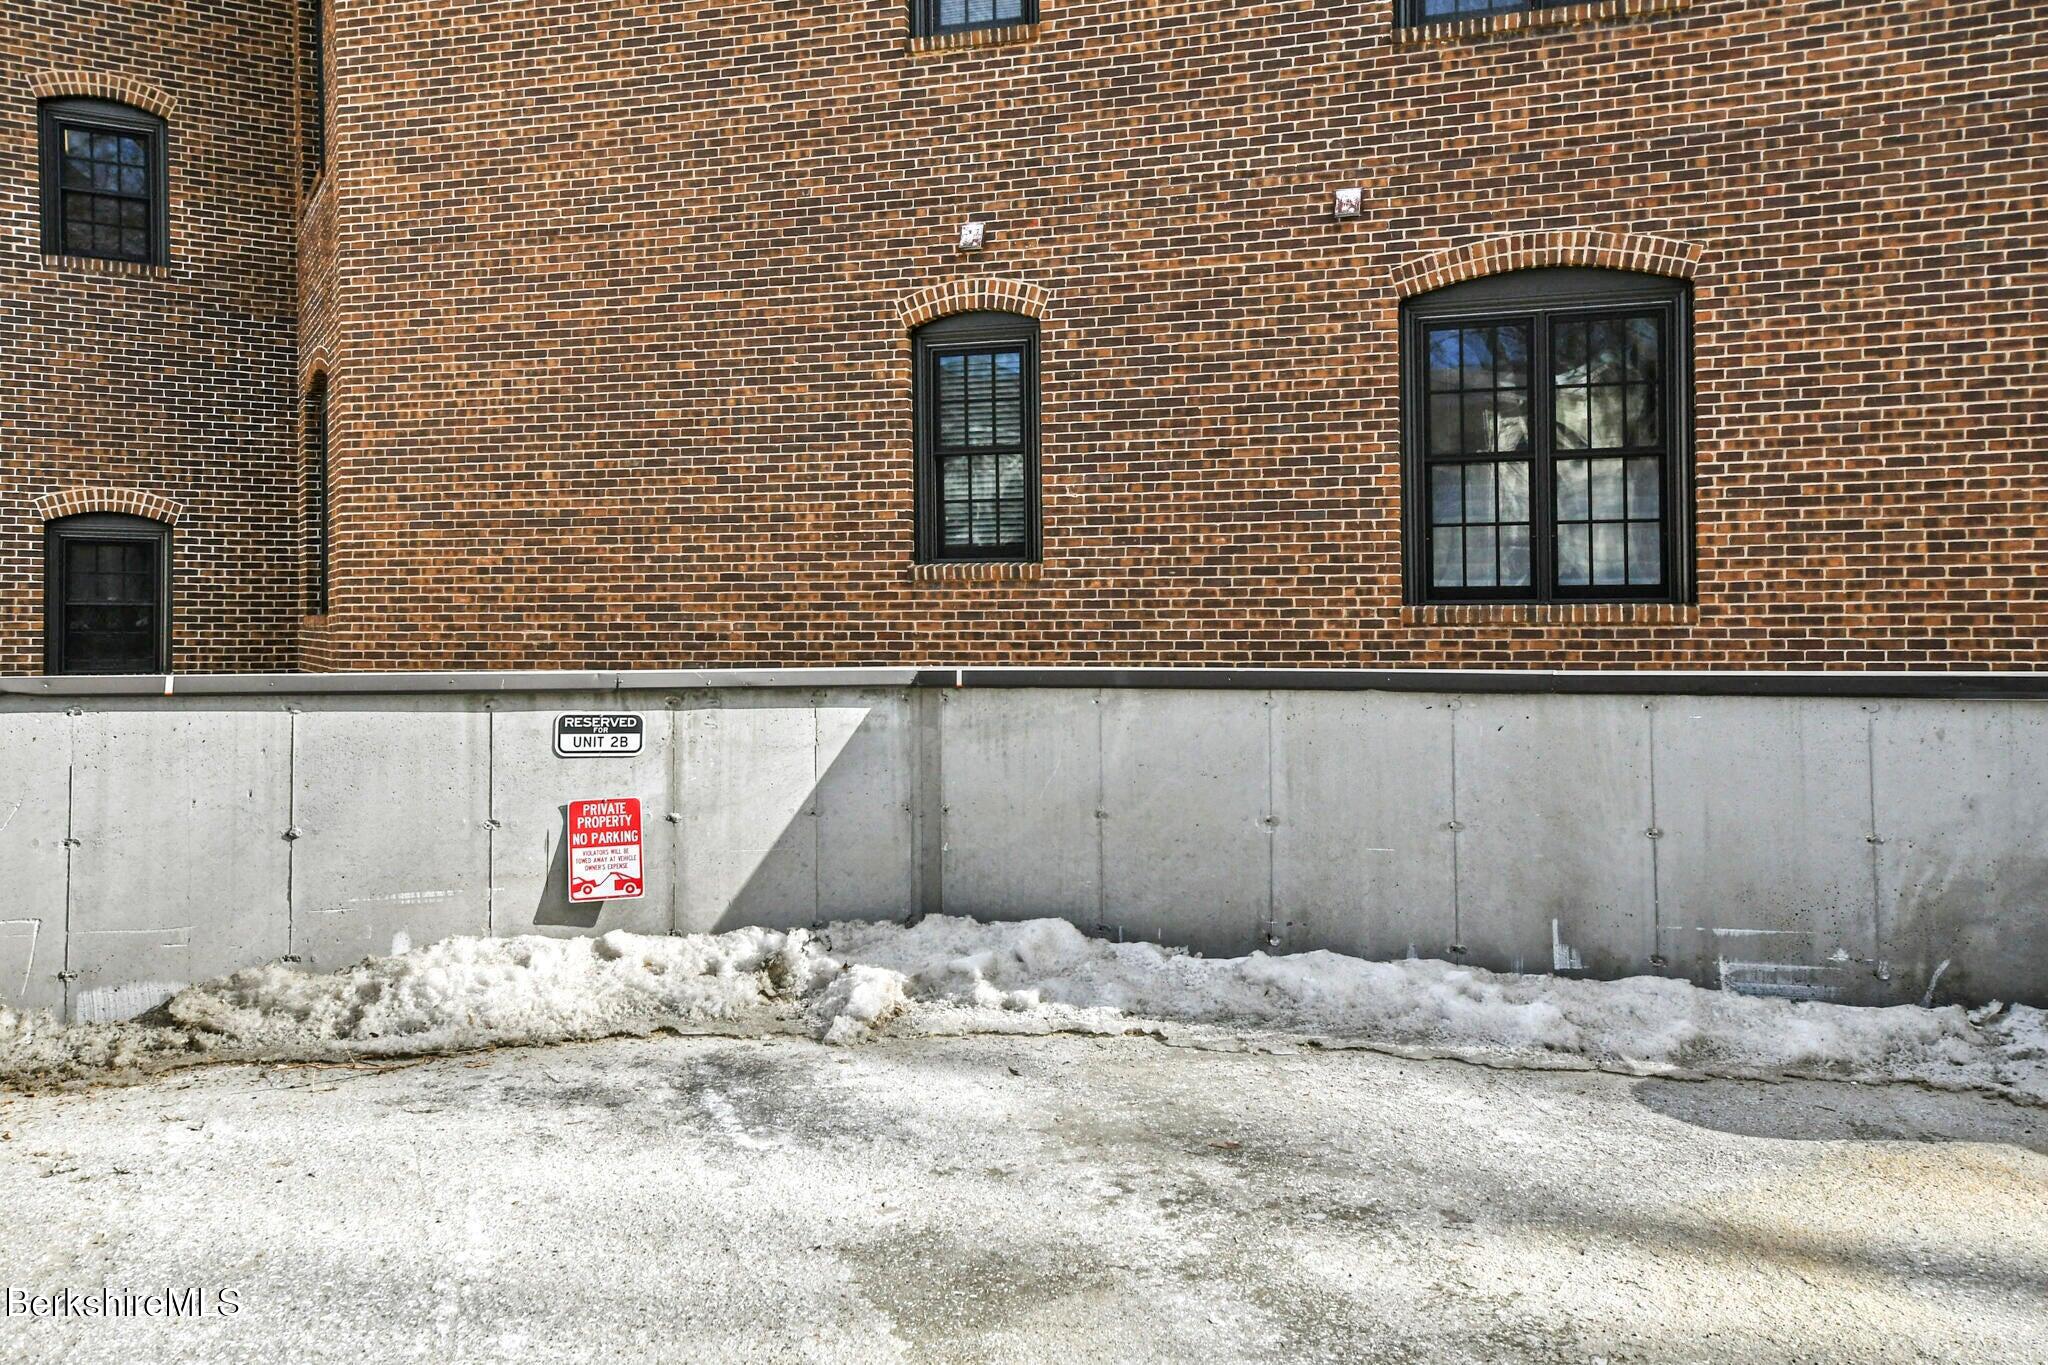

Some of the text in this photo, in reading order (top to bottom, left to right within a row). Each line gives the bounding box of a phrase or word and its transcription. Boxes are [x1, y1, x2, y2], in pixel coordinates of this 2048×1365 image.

[565, 717, 637, 727] RESERVED
[573, 736, 628, 748] UNIT 2B
[583, 802, 626, 816] PRIVATE
[577, 814, 632, 829] PROPERTY
[572, 830, 639, 845] NO PARKING
